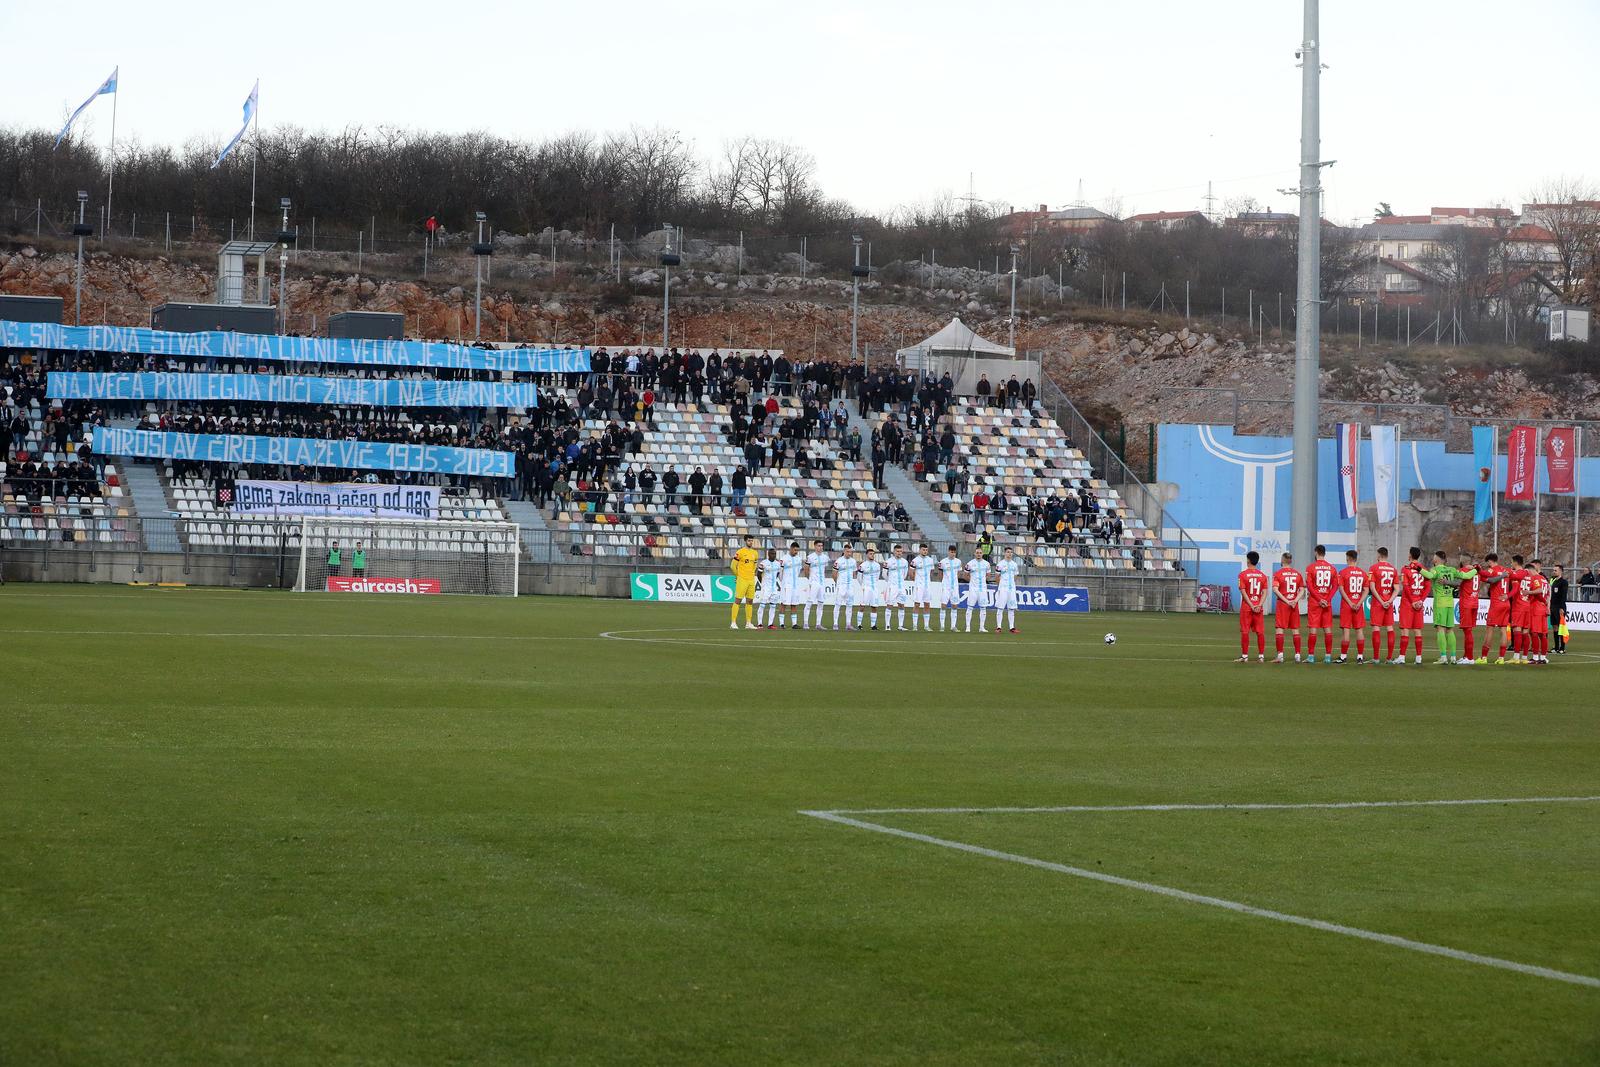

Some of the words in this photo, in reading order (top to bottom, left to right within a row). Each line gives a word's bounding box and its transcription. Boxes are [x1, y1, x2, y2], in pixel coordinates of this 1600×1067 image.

[83, 326, 140, 352] JEDNA
[151, 331, 212, 356] STVAR
[222, 331, 272, 359] NEMA
[351, 339, 410, 365] VELIKA
[446, 344, 471, 369] MA
[527, 349, 587, 373] VELIKA
[155, 372, 260, 401] PRIVILEGIJA
[268, 375, 311, 402] MOĆI
[399, 379, 424, 407] NA
[101, 429, 199, 460] MIROSLAV
[207, 434, 257, 463] ČIRO
[268, 437, 374, 469] BLAŽEVIĆ
[234, 484, 273, 512] nema
[279, 484, 331, 506] zakona
[337, 489, 377, 513] jačeg
[383, 486, 400, 510] od
[406, 490, 431, 518] nas
[352, 578, 418, 593] aircash
[664, 578, 705, 592] SAVA
[1248, 577, 1261, 595] 14
[1284, 576, 1297, 593] 15
[1316, 570, 1331, 587] 89
[1349, 576, 1364, 593] 88
[1380, 571, 1394, 588] 25
[1411, 573, 1425, 590] 32
[1566, 611, 1585, 623] SAVA
